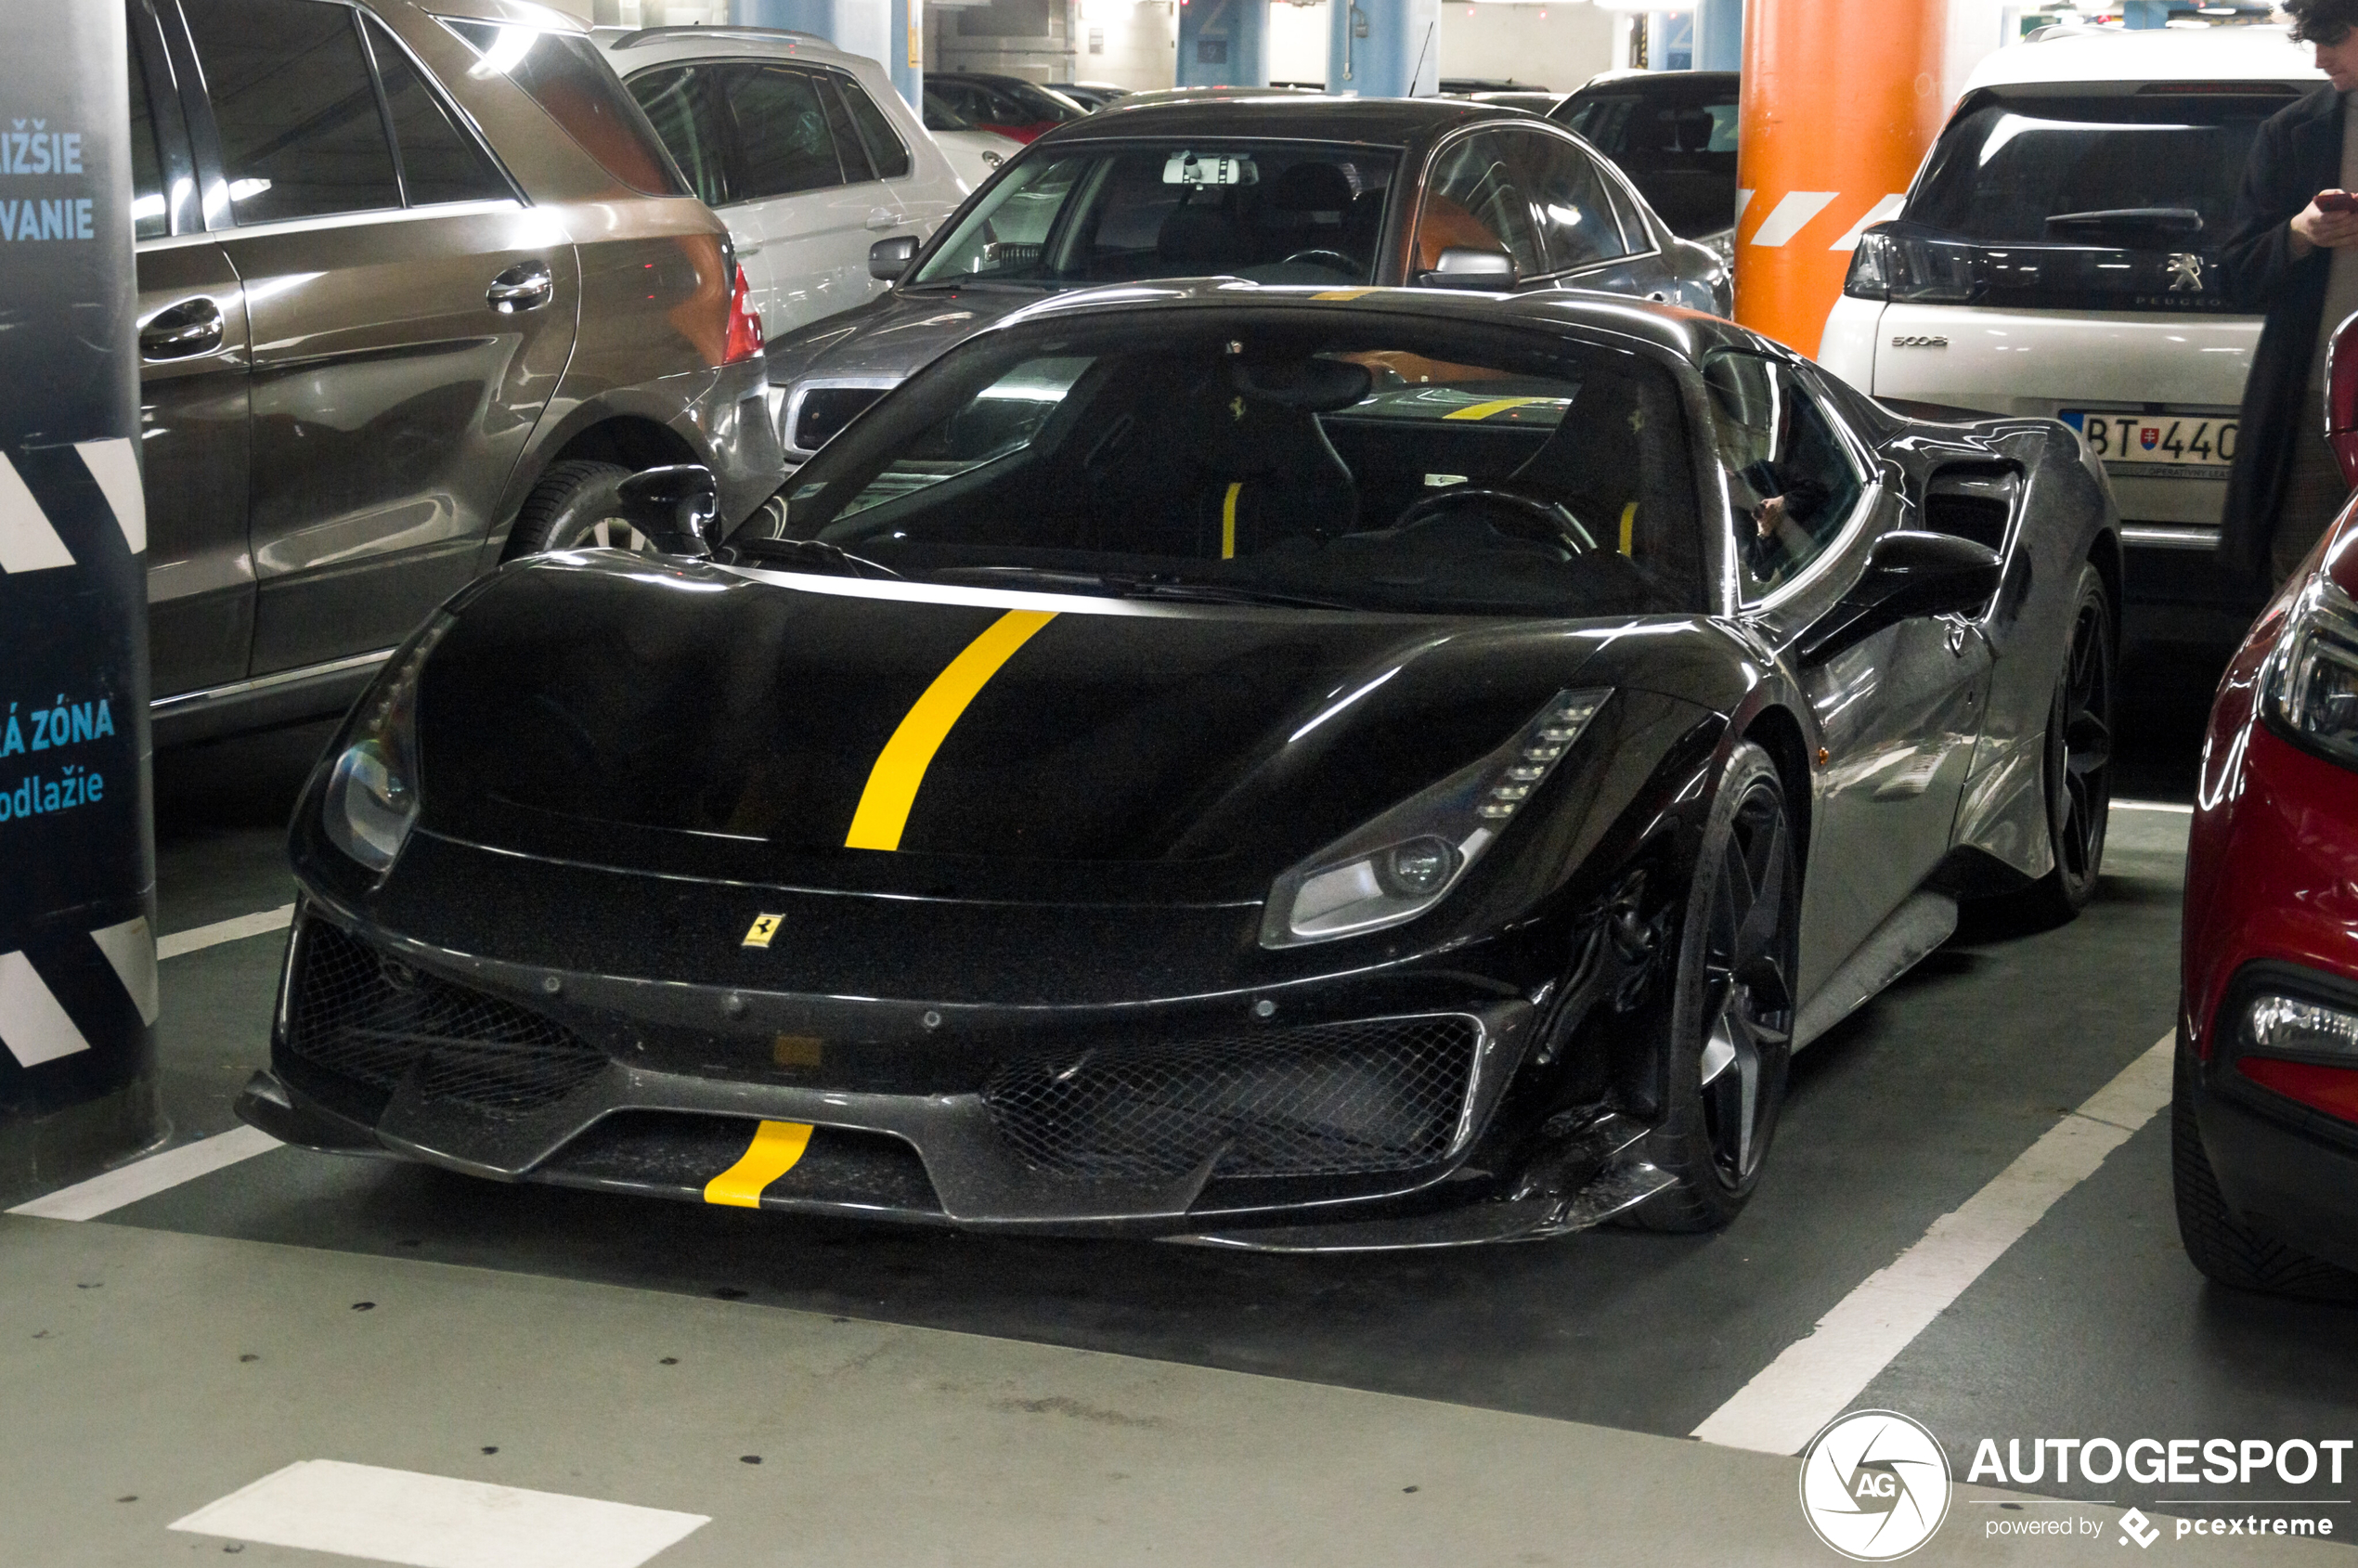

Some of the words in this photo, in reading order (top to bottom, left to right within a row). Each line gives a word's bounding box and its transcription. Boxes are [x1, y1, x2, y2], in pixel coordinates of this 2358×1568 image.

[0, 118, 83, 174] IŽŠIE
[2135, 296, 2222, 307] PEUGEO
[2088, 418, 2139, 458] BT
[0, 702, 26, 758] Á
[31, 693, 115, 751] ZÓNA
[0, 764, 104, 823] odlažie
